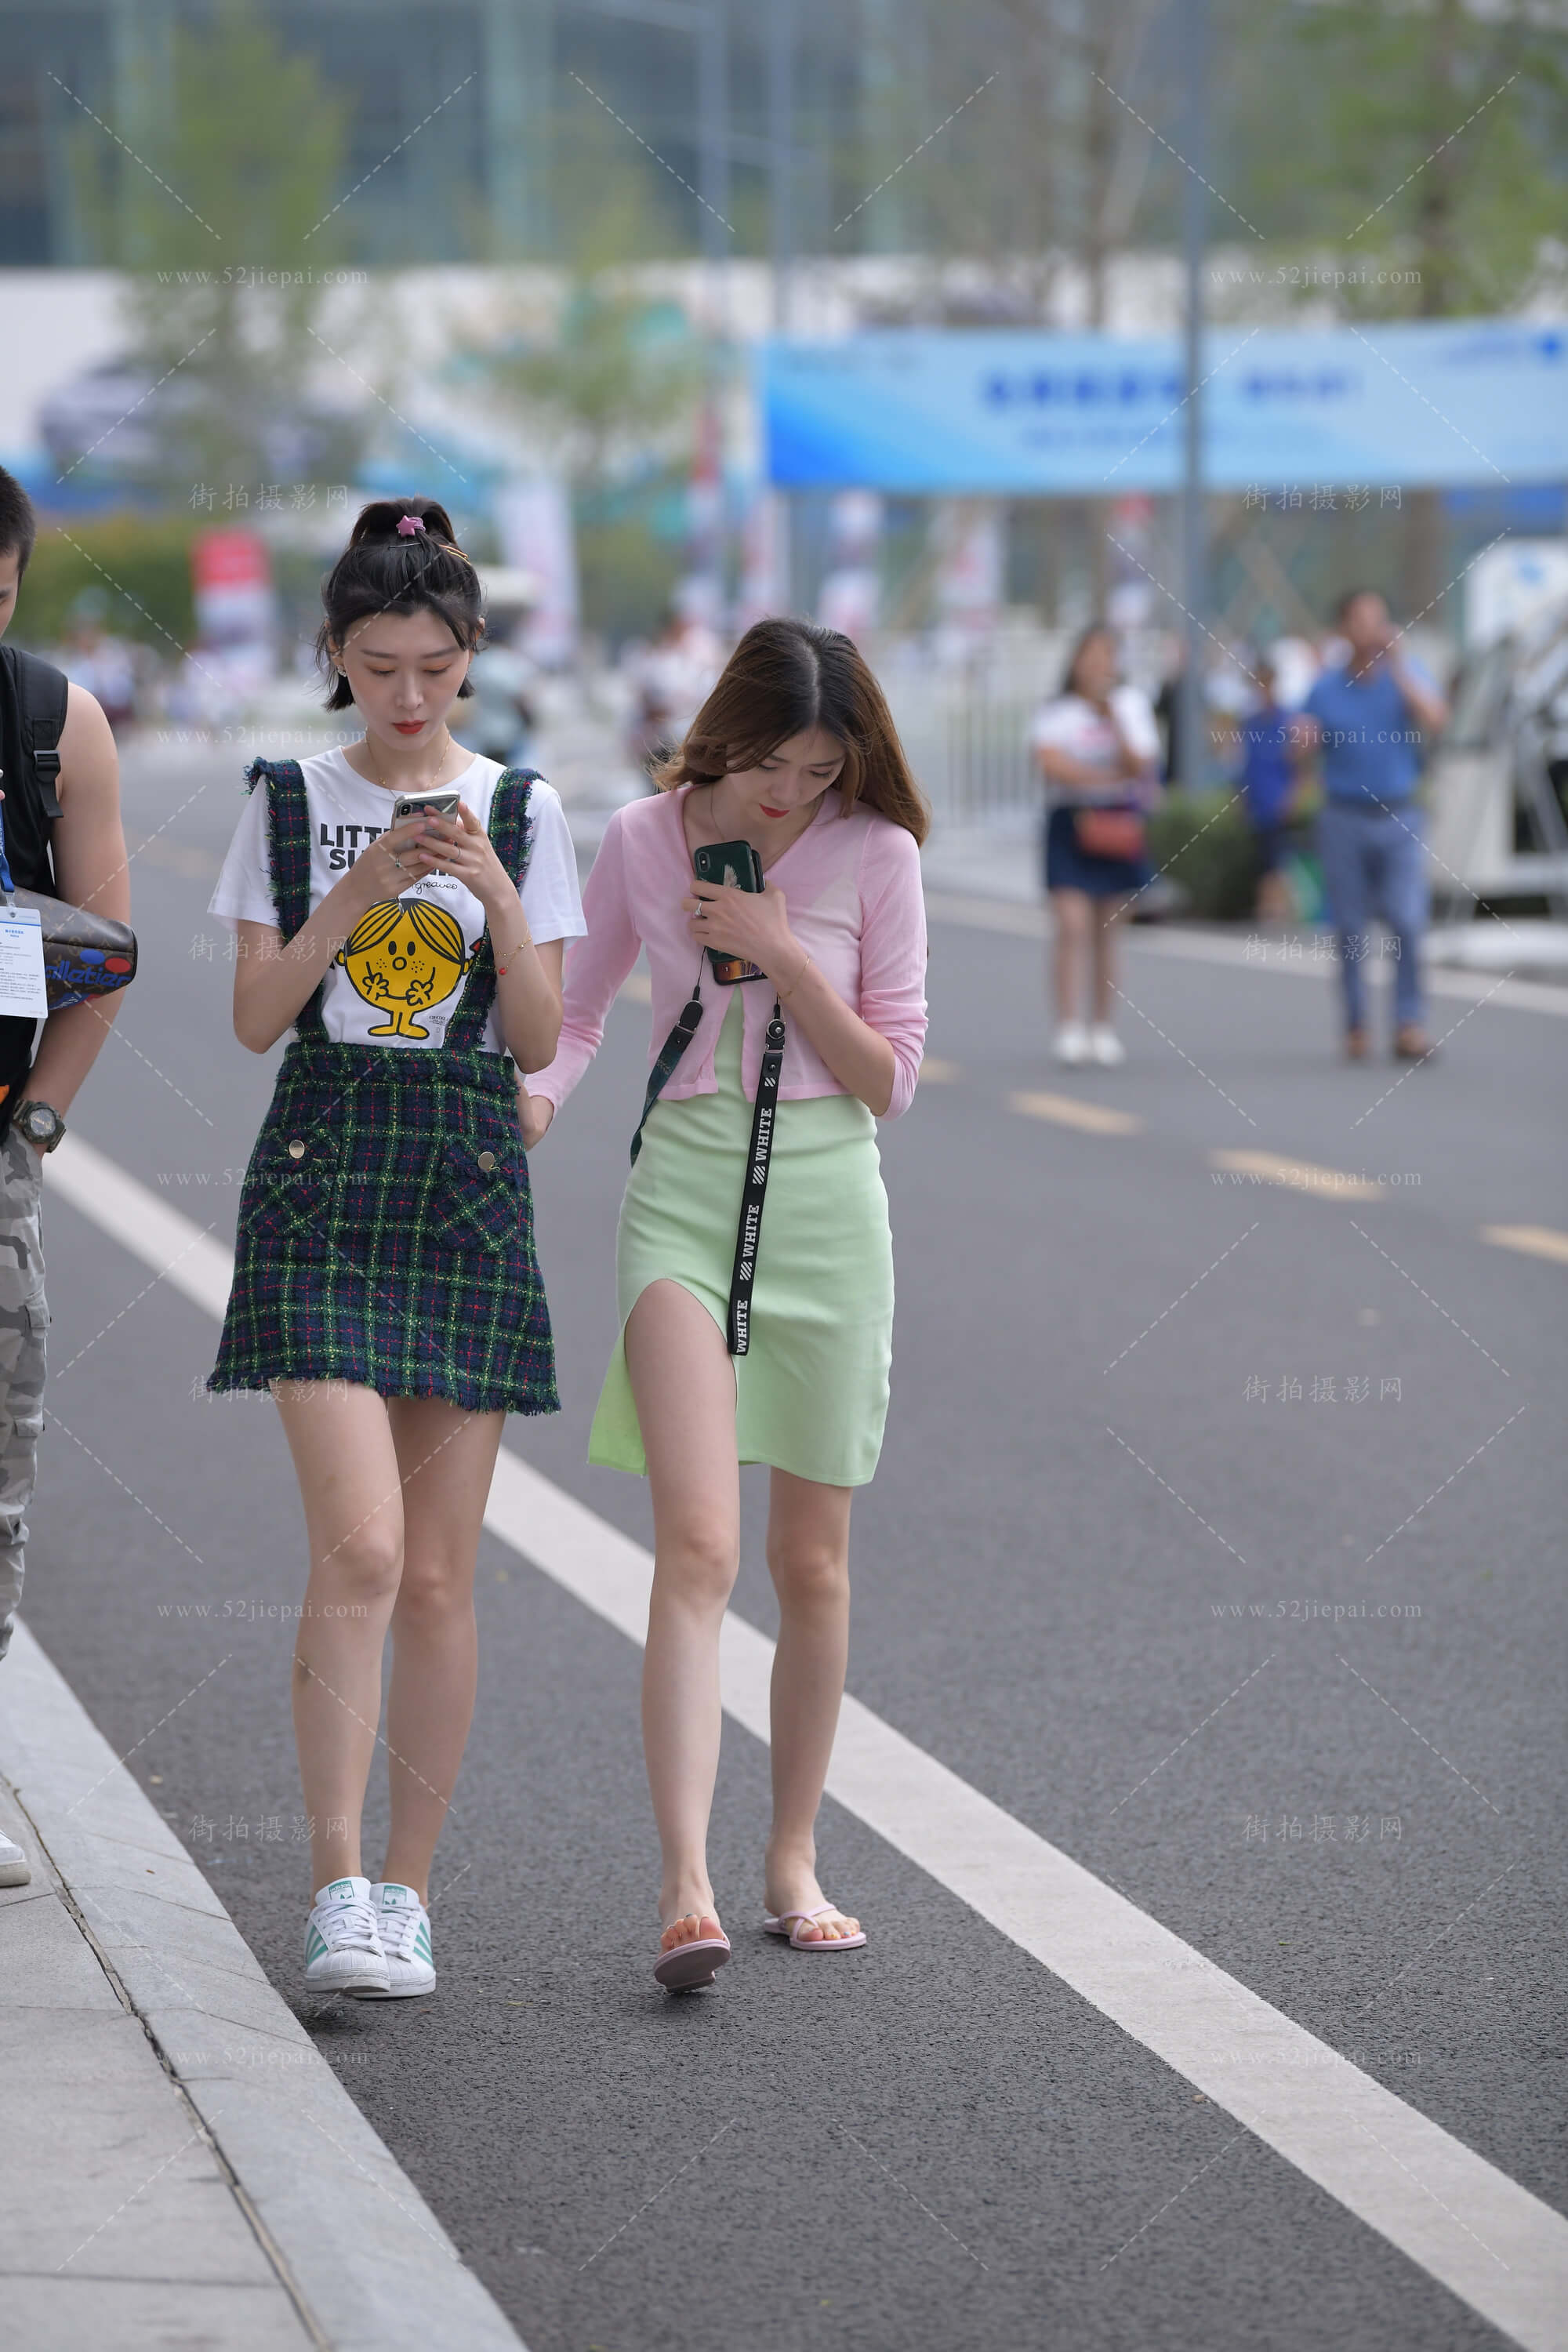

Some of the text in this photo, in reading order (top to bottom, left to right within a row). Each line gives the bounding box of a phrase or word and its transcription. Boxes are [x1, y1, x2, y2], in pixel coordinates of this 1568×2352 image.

[412, 881, 458, 895] greaves
[45, 960, 132, 988] alletier
[755, 1108, 772, 1162] WHITE
[742, 1204, 760, 1258] WHITE
[736, 1300, 748, 1354] WHITE
